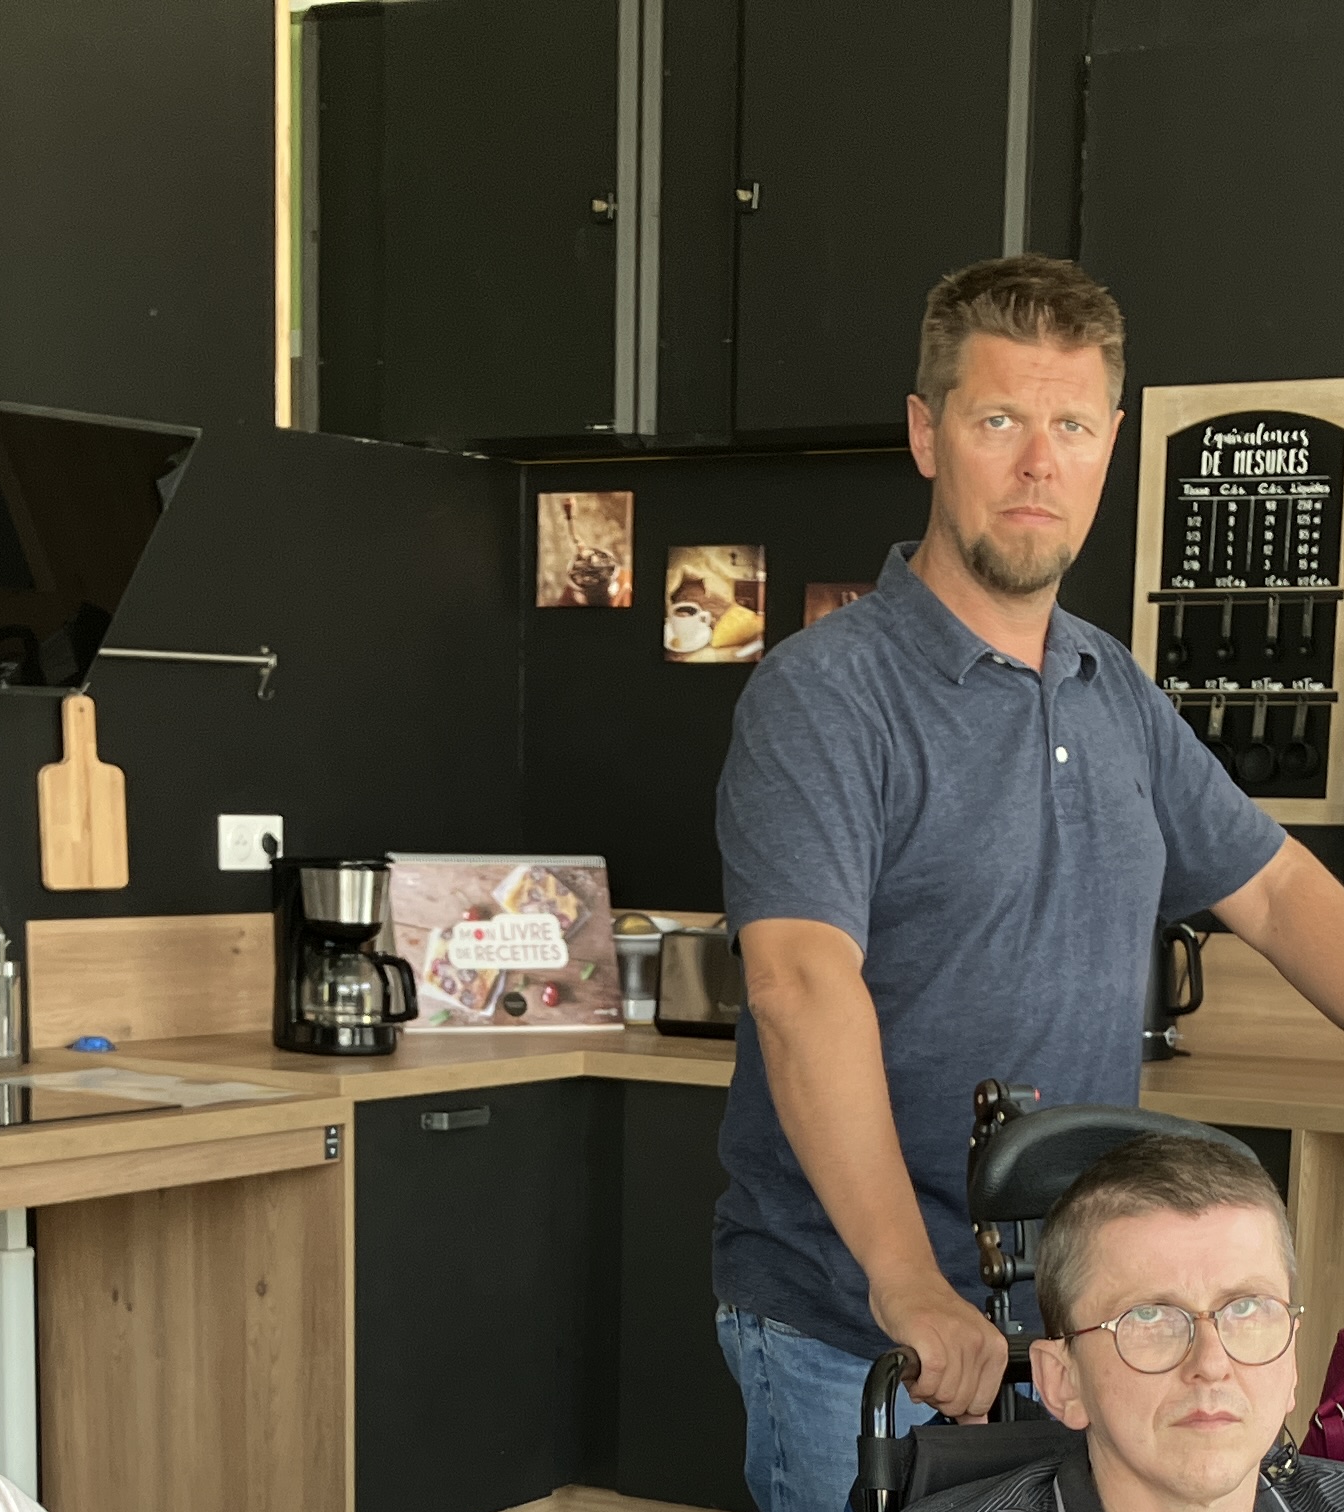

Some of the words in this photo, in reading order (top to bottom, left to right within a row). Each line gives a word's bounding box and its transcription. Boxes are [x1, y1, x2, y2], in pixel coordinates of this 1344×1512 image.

[1200, 450, 1223, 476] DE
[1233, 448, 1309, 475] MESURES
[500, 922, 553, 941] LIVRE
[474, 944, 561, 961] RECETTES
